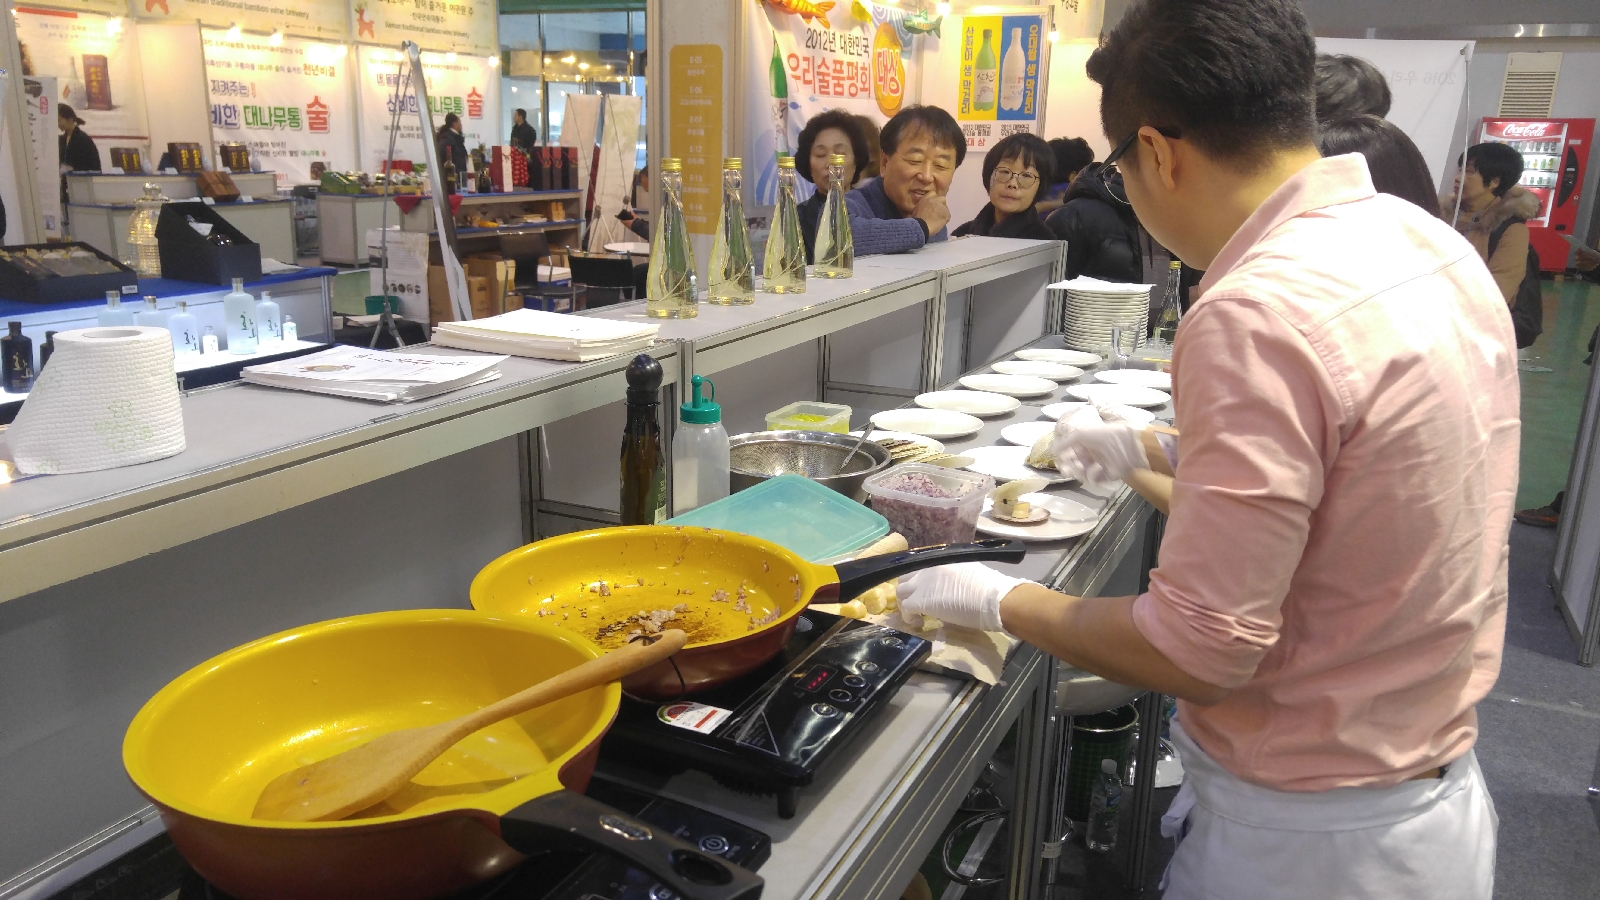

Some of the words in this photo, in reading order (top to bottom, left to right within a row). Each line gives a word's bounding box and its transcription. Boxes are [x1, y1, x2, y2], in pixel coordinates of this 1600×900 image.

[805, 27, 836, 53] 2012년
[839, 33, 870, 59] 대한민국
[303, 62, 336, 78] 천년비결
[689, 56, 703, 64] E-05
[787, 52, 871, 99] 우리술품평회
[876, 49, 901, 96] 대상
[242, 104, 301, 129] 대나무통
[306, 95, 329, 131] 술
[466, 86, 483, 118] 술
[961, 79, 972, 115] 막걸리
[1024, 79, 1035, 115] 막걸리
[1502, 123, 1549, 138] Coca-Cola
[689, 145, 703, 153] E-12
[689, 174, 703, 182] E-13
